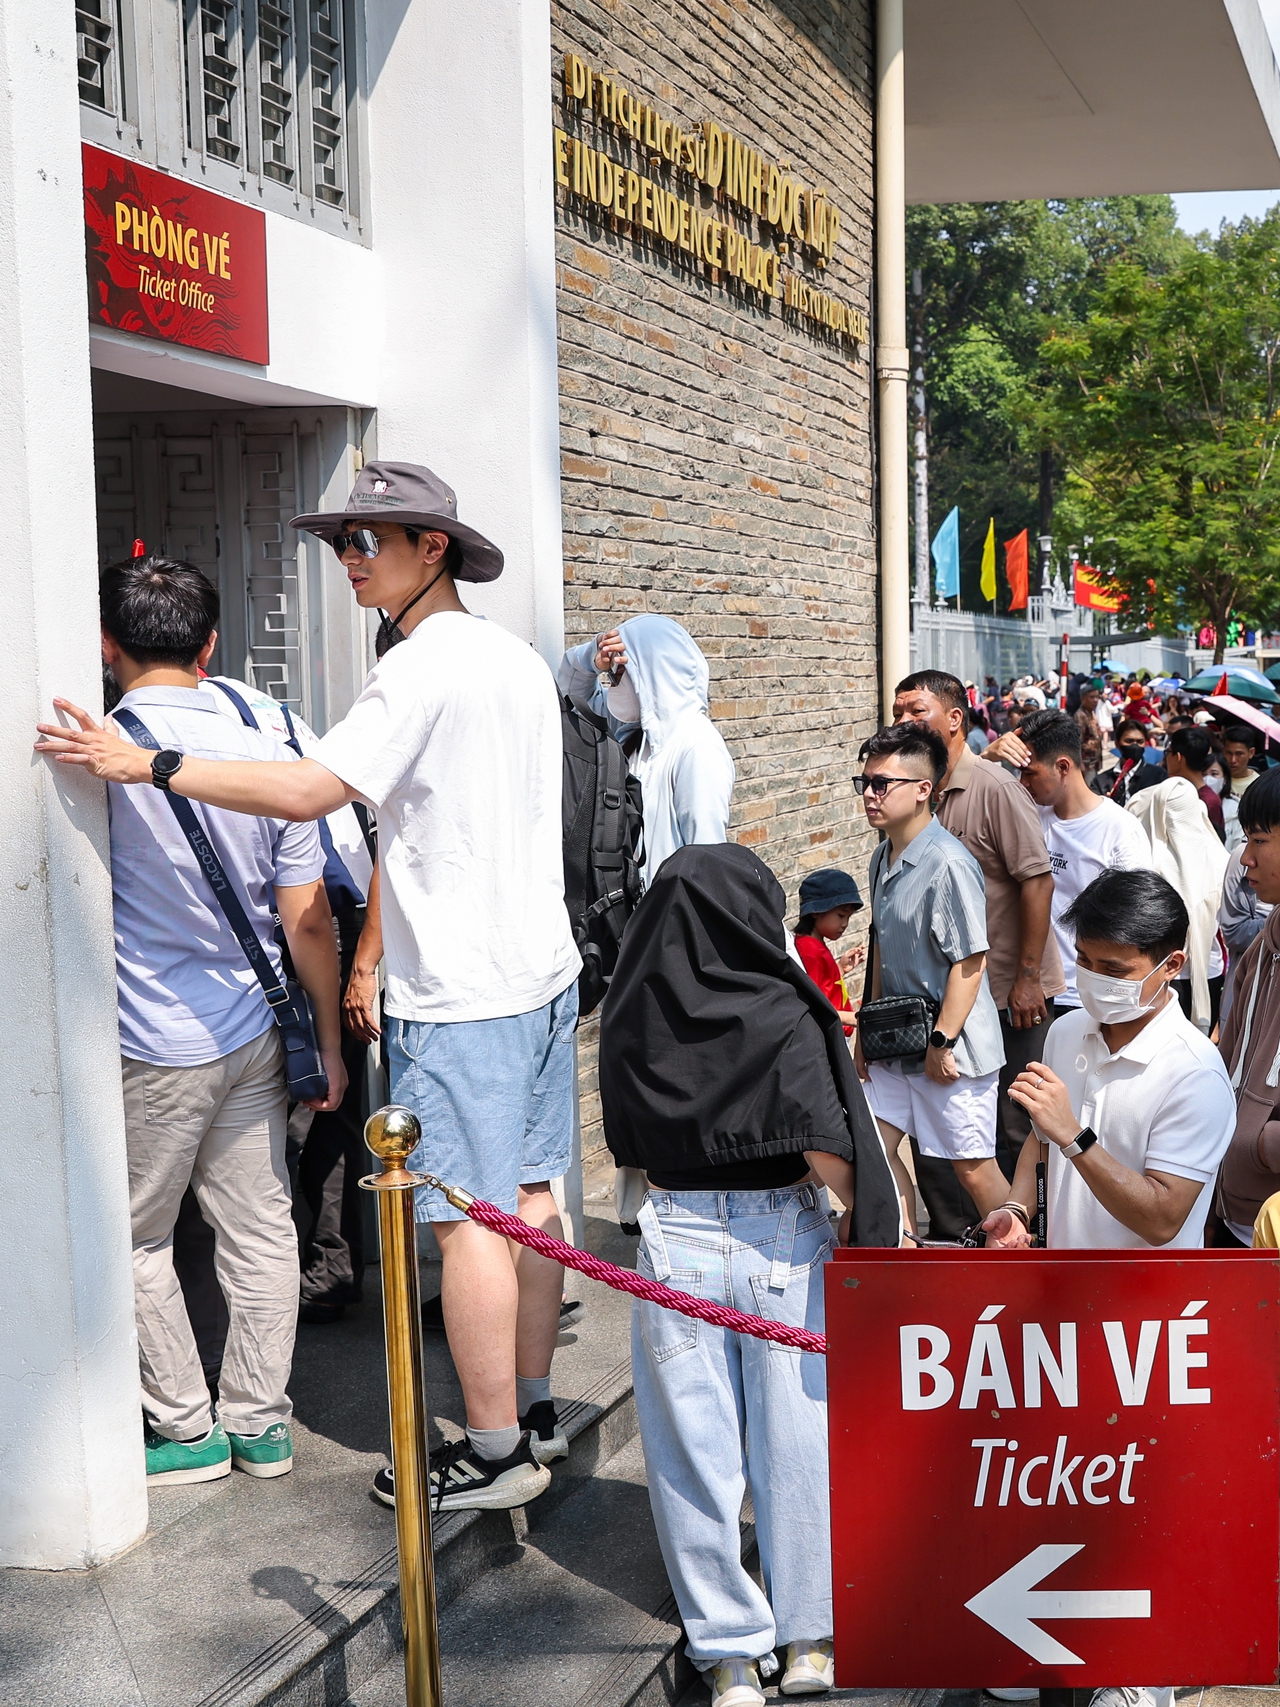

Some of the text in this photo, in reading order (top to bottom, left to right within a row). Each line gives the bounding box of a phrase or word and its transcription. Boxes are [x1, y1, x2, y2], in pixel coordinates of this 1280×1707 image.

[708, 122, 762, 216] DINH
[115, 201, 232, 280] PHÒNG VÉ
[573, 138, 722, 268] INDEPENDENCE
[726, 226, 781, 298] PALACE
[138, 265, 216, 314] Ticket Office
[189, 829, 227, 891] LACOSTE
[900, 1300, 1211, 1411] BÁN VÉ
[971, 1436, 1145, 1507] Ticket
